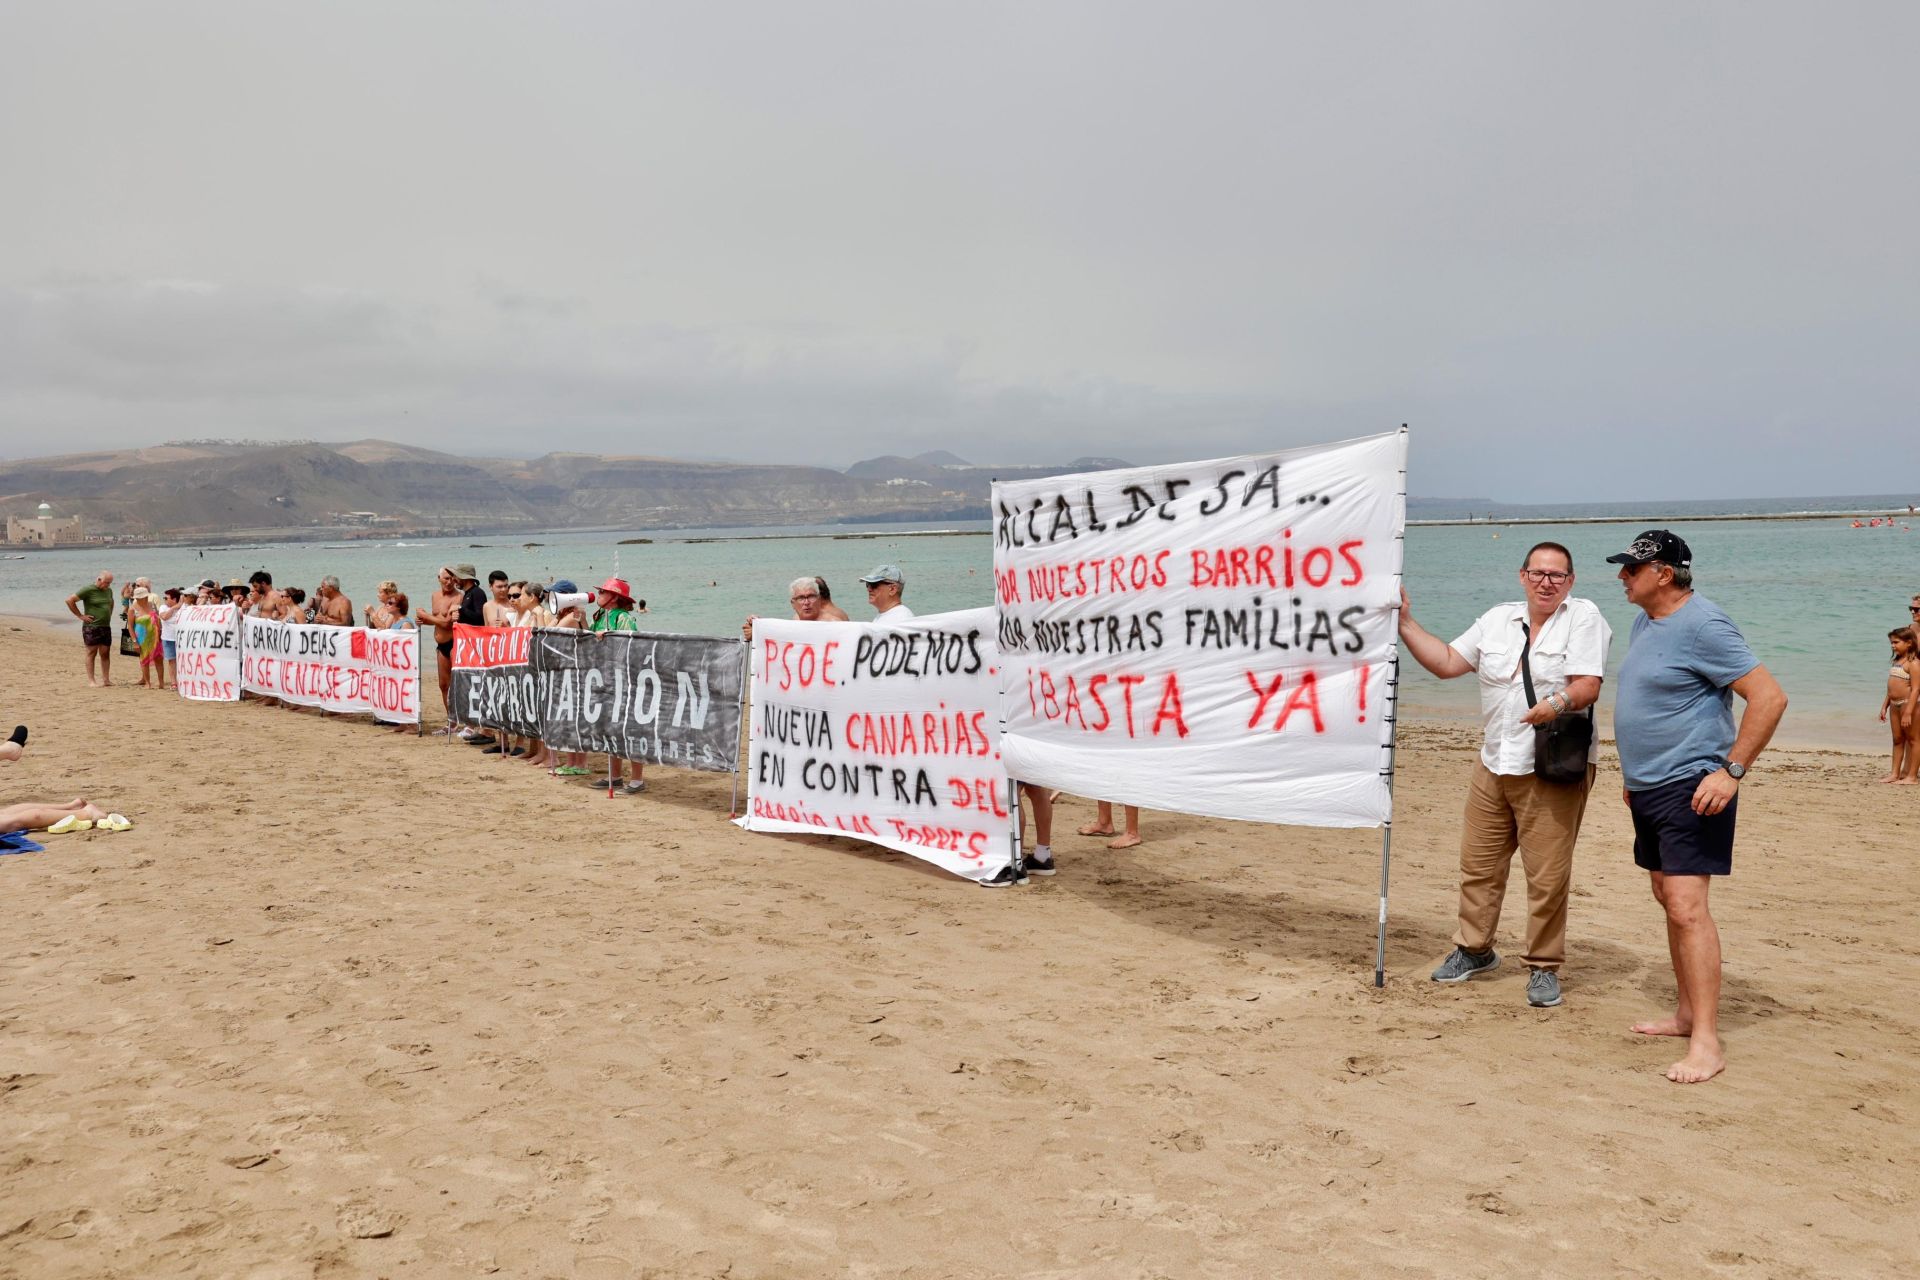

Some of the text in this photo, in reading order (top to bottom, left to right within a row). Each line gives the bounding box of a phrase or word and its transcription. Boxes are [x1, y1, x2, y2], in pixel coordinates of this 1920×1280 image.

[1027, 549, 1170, 603] NUESTROS
[352, 630, 418, 670] ORRES.
[1032, 610, 1164, 655] NUESTRAS
[257, 655, 273, 688] SE
[590, 734, 714, 763] LAS TORRES
[758, 751, 1008, 818] EN CONTRA DEL
